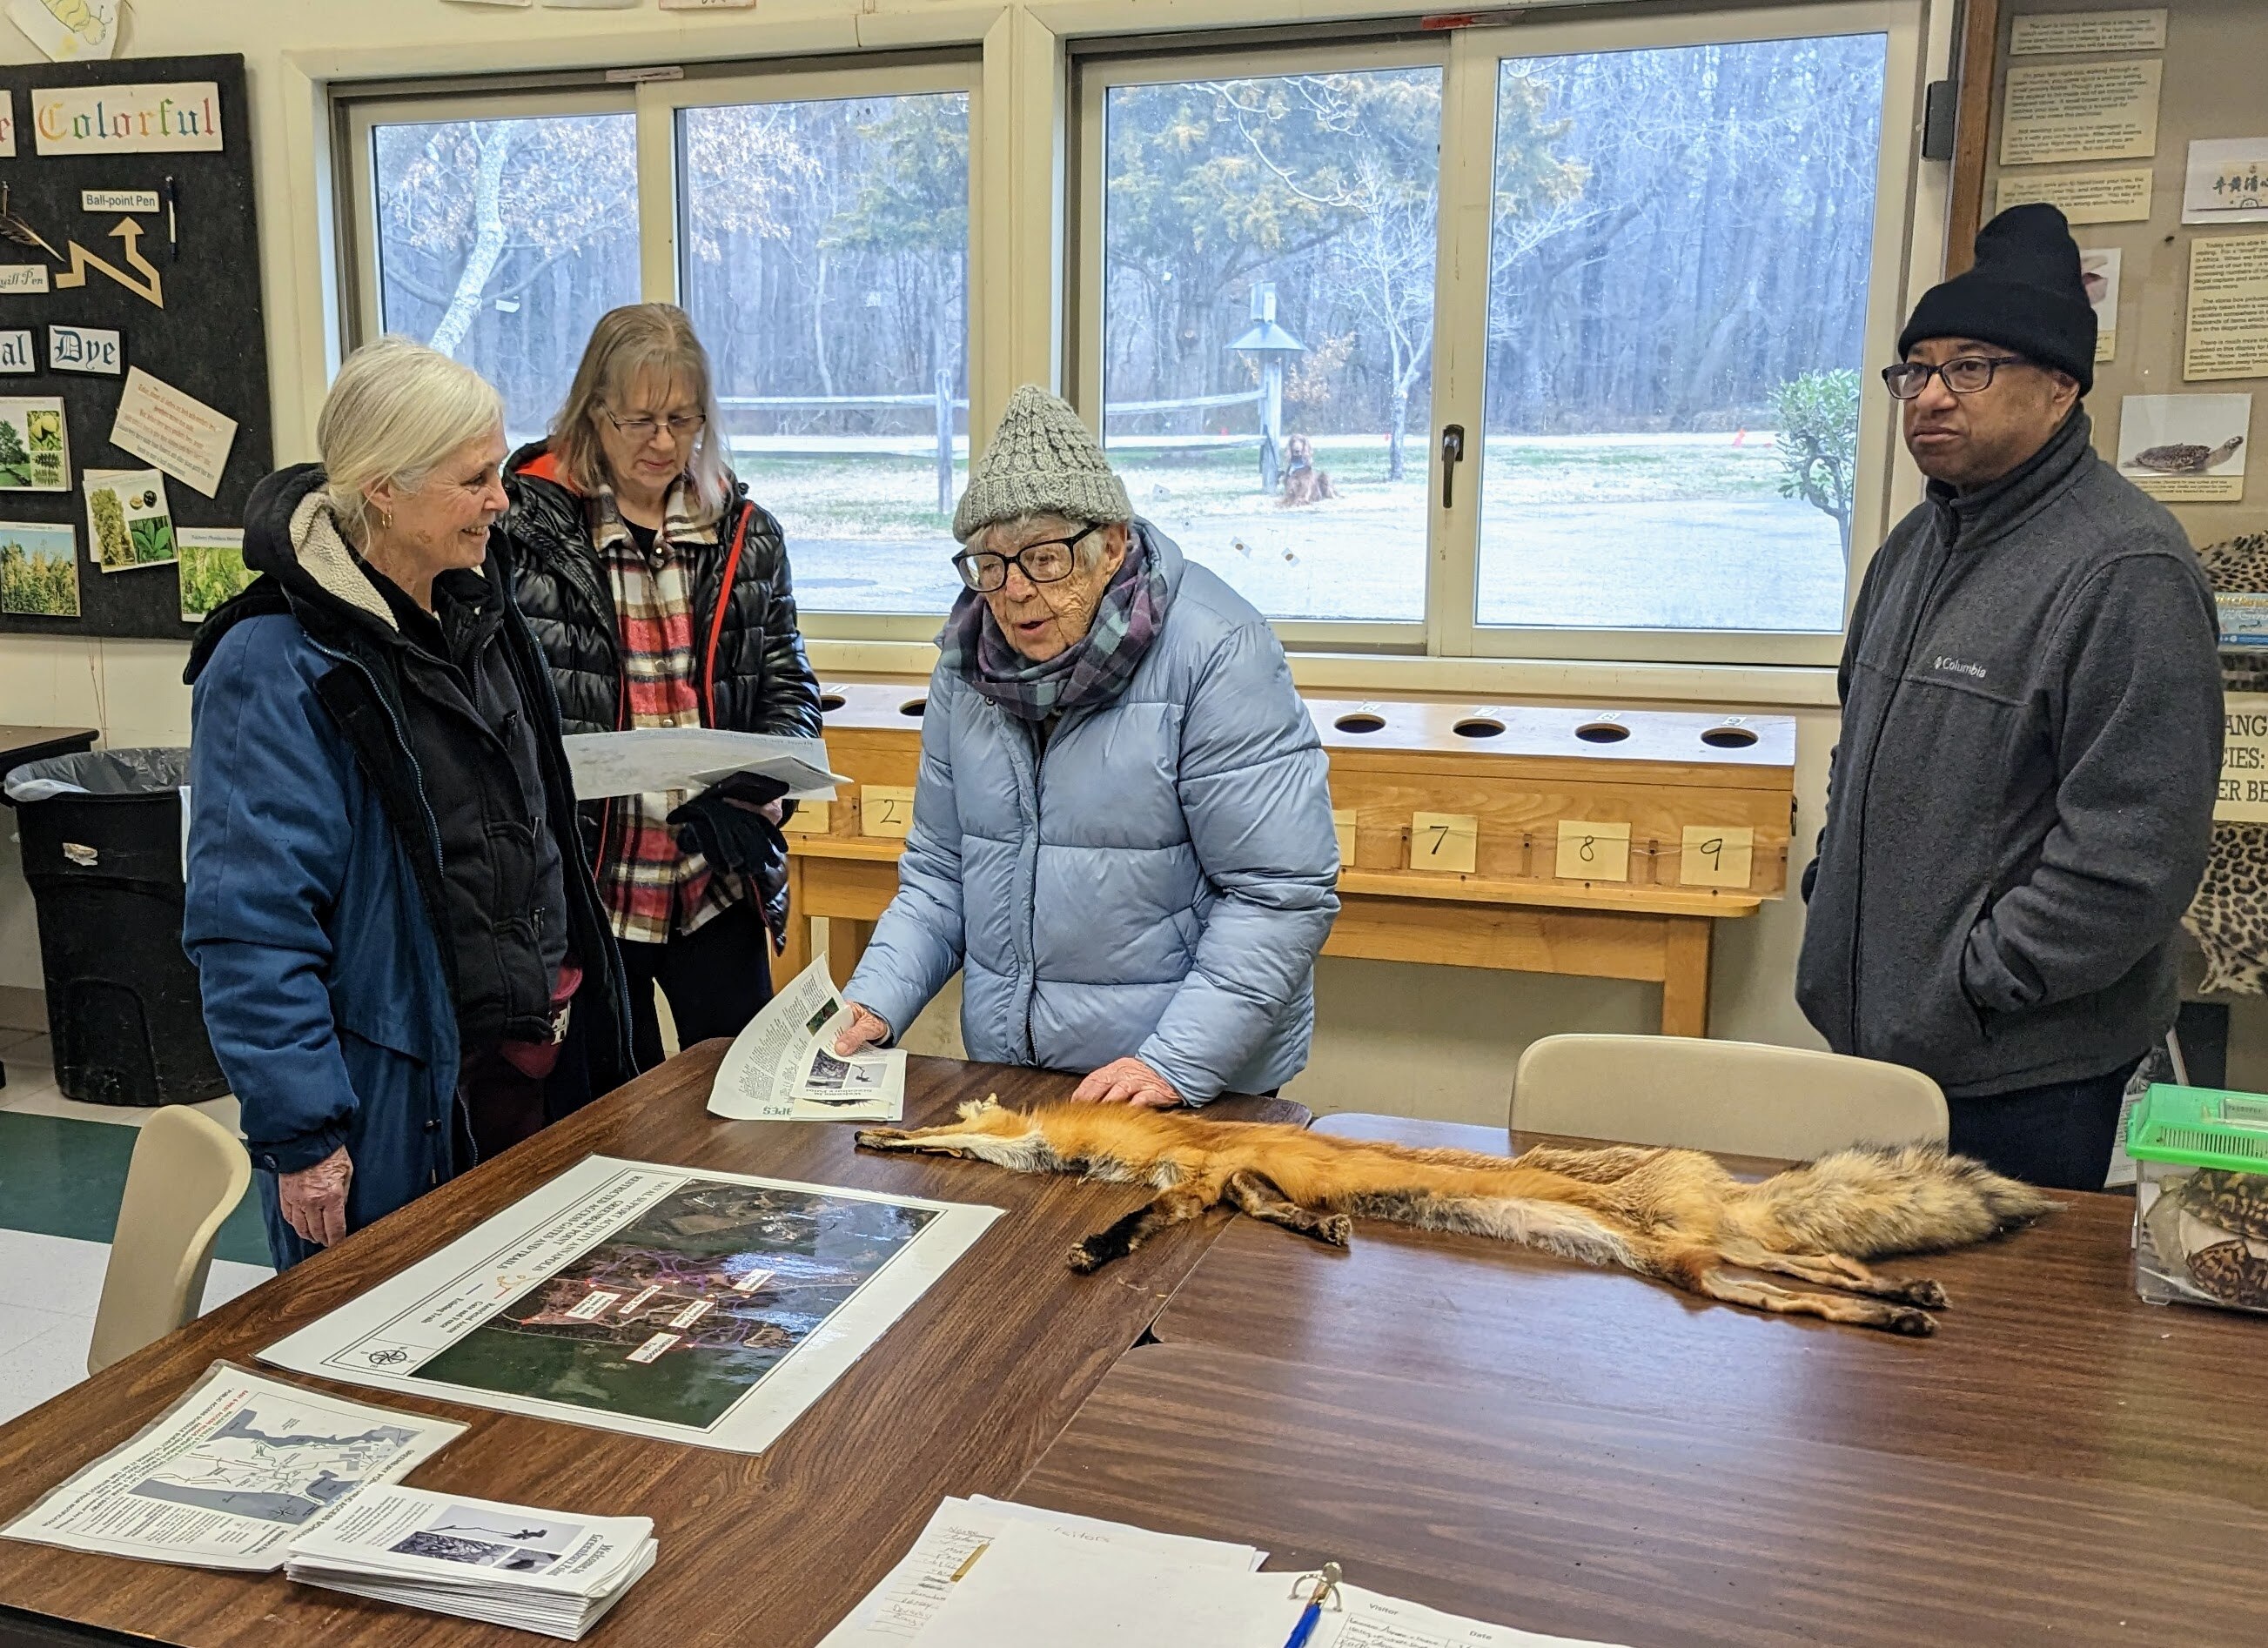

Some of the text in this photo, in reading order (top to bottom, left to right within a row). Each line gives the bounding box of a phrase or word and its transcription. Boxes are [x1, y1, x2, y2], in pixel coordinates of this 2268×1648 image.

[38, 97, 217, 141] Colorful
[85, 193, 156, 208] Ball-point Pen
[0, 273, 19, 289] uill
[53, 328, 117, 370] Dye
[1943, 657, 1986, 678] Columbia
[880, 799, 902, 825] 2
[1429, 825, 1449, 855] 7
[1580, 834, 1594, 861] 8
[1701, 838, 1723, 871] 9
[493, 1175, 644, 1269] RESTRICTED ACCESS GATES AND TRAILS
[529, 1181, 671, 1271] NAVAL SUPPORT ACTIVITY ANNAPOLIS
[550, 1200, 626, 1245] GREENBURY POINT
[1369, 1603, 1399, 1616] Visitor
[1469, 1630, 1493, 1640] Date
